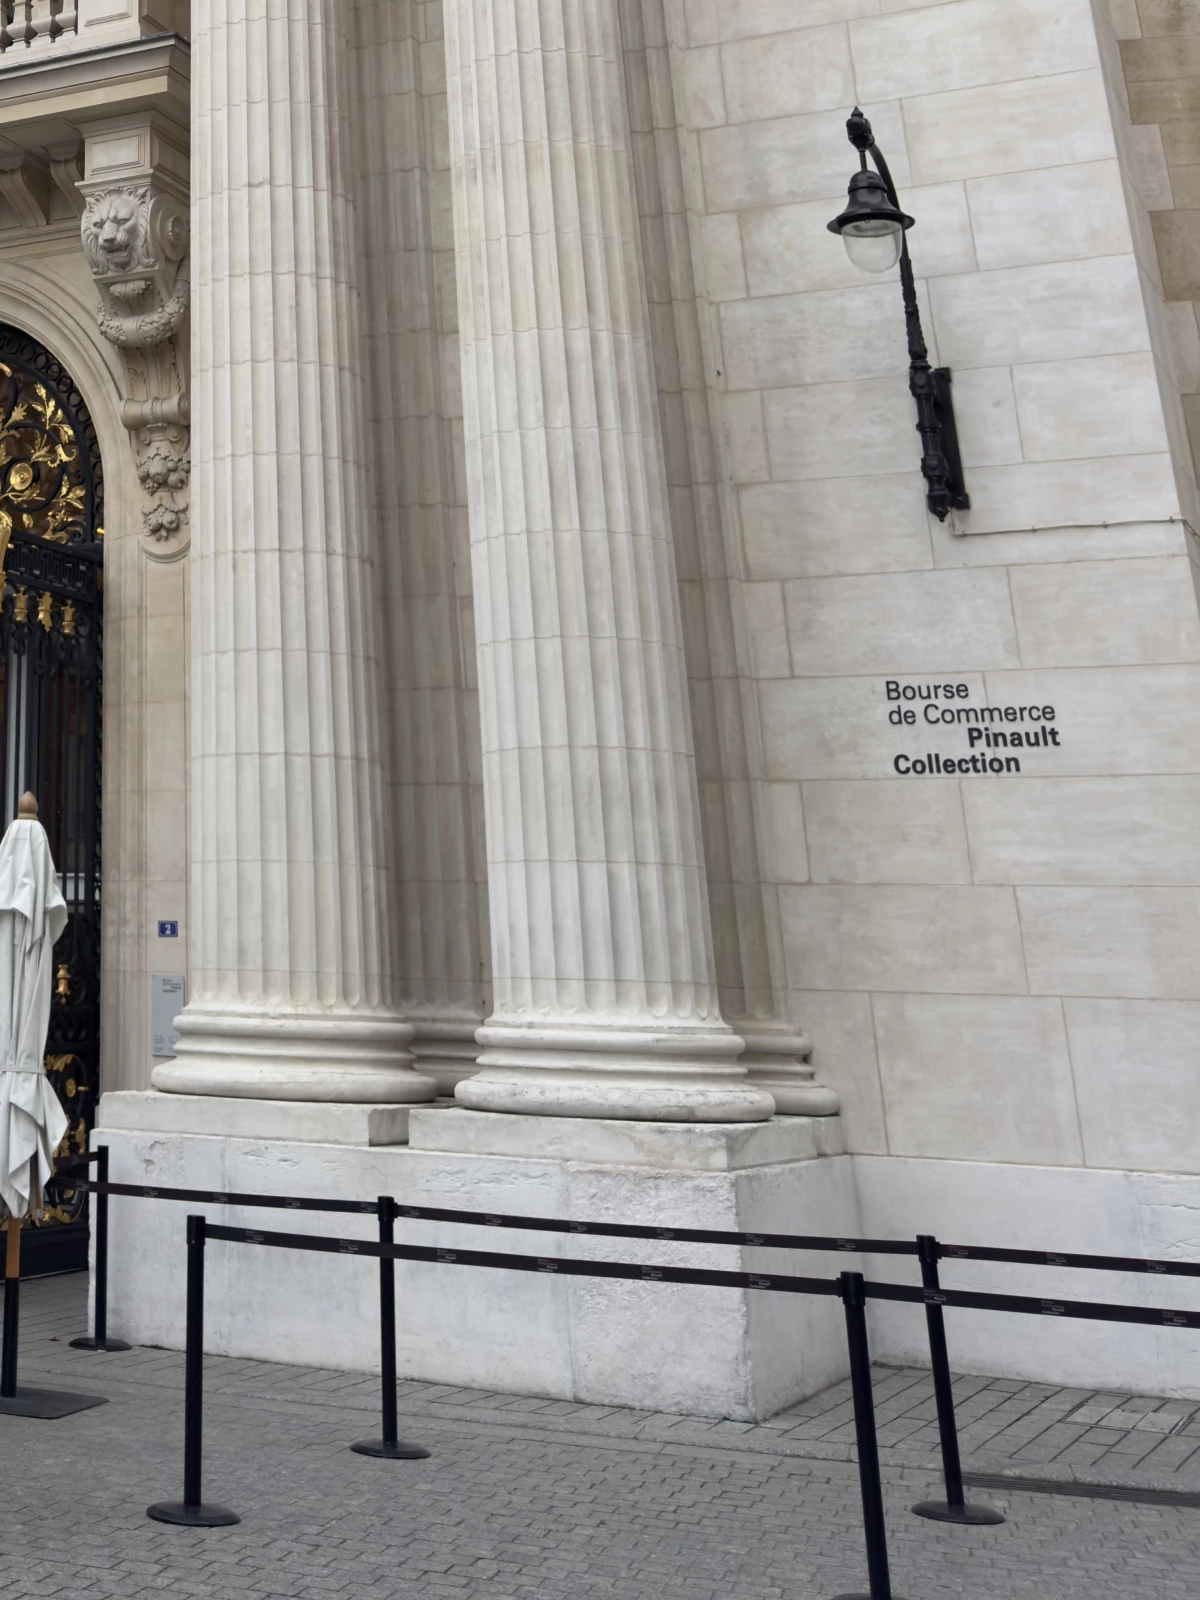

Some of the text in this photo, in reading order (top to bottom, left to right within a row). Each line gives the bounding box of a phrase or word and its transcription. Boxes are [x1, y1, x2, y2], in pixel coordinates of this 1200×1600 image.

[885, 680, 969, 701] Bourse
[888, 703, 1056, 725] de Commerce
[967, 725, 1061, 748] Pinault
[893, 753, 1021, 775] Collection
[165, 924, 171, 934] 2
